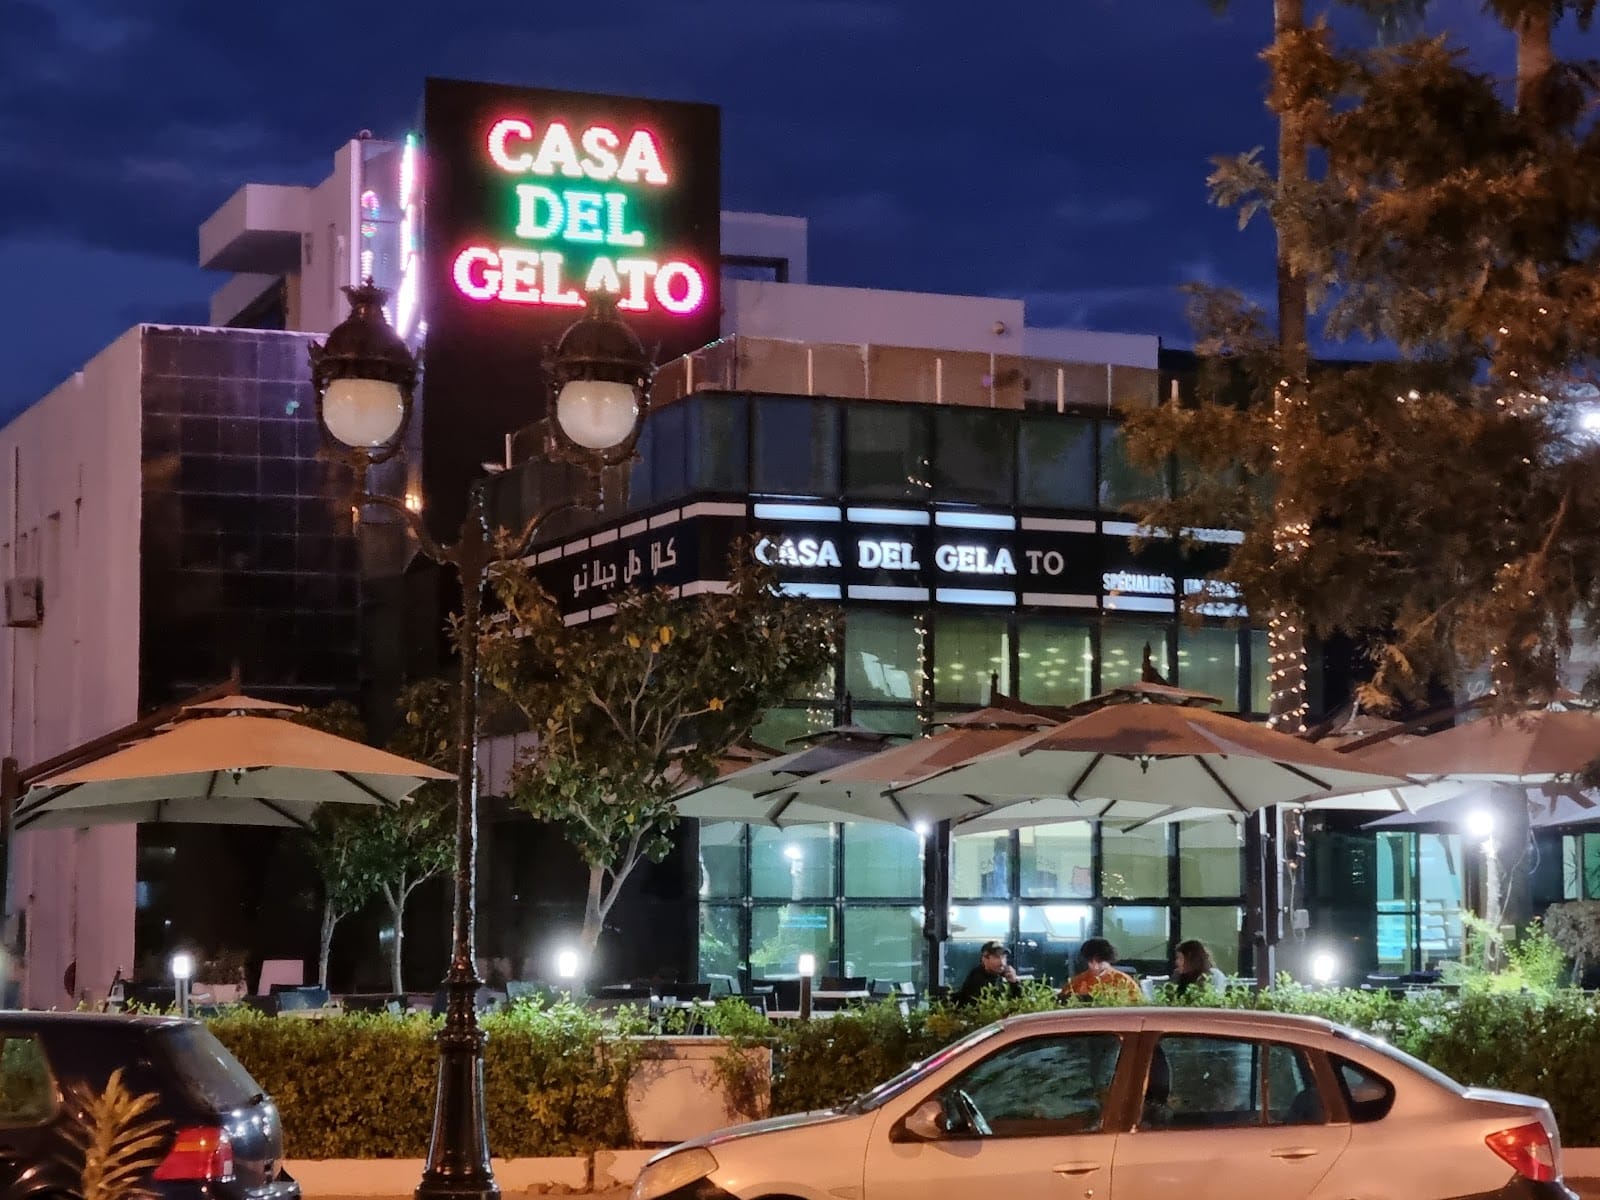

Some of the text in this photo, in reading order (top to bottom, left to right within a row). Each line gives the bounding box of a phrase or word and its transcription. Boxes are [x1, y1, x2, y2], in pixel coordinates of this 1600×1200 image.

[487, 119, 668, 184] CASA
[515, 185, 645, 247] DEL
[453, 247, 704, 313] GELATO
[623, 548, 642, 584] دل
[754, 537, 842, 568] CASA
[857, 540, 921, 571] DEL
[1102, 569, 1176, 595] SPÉCIALITÉS
